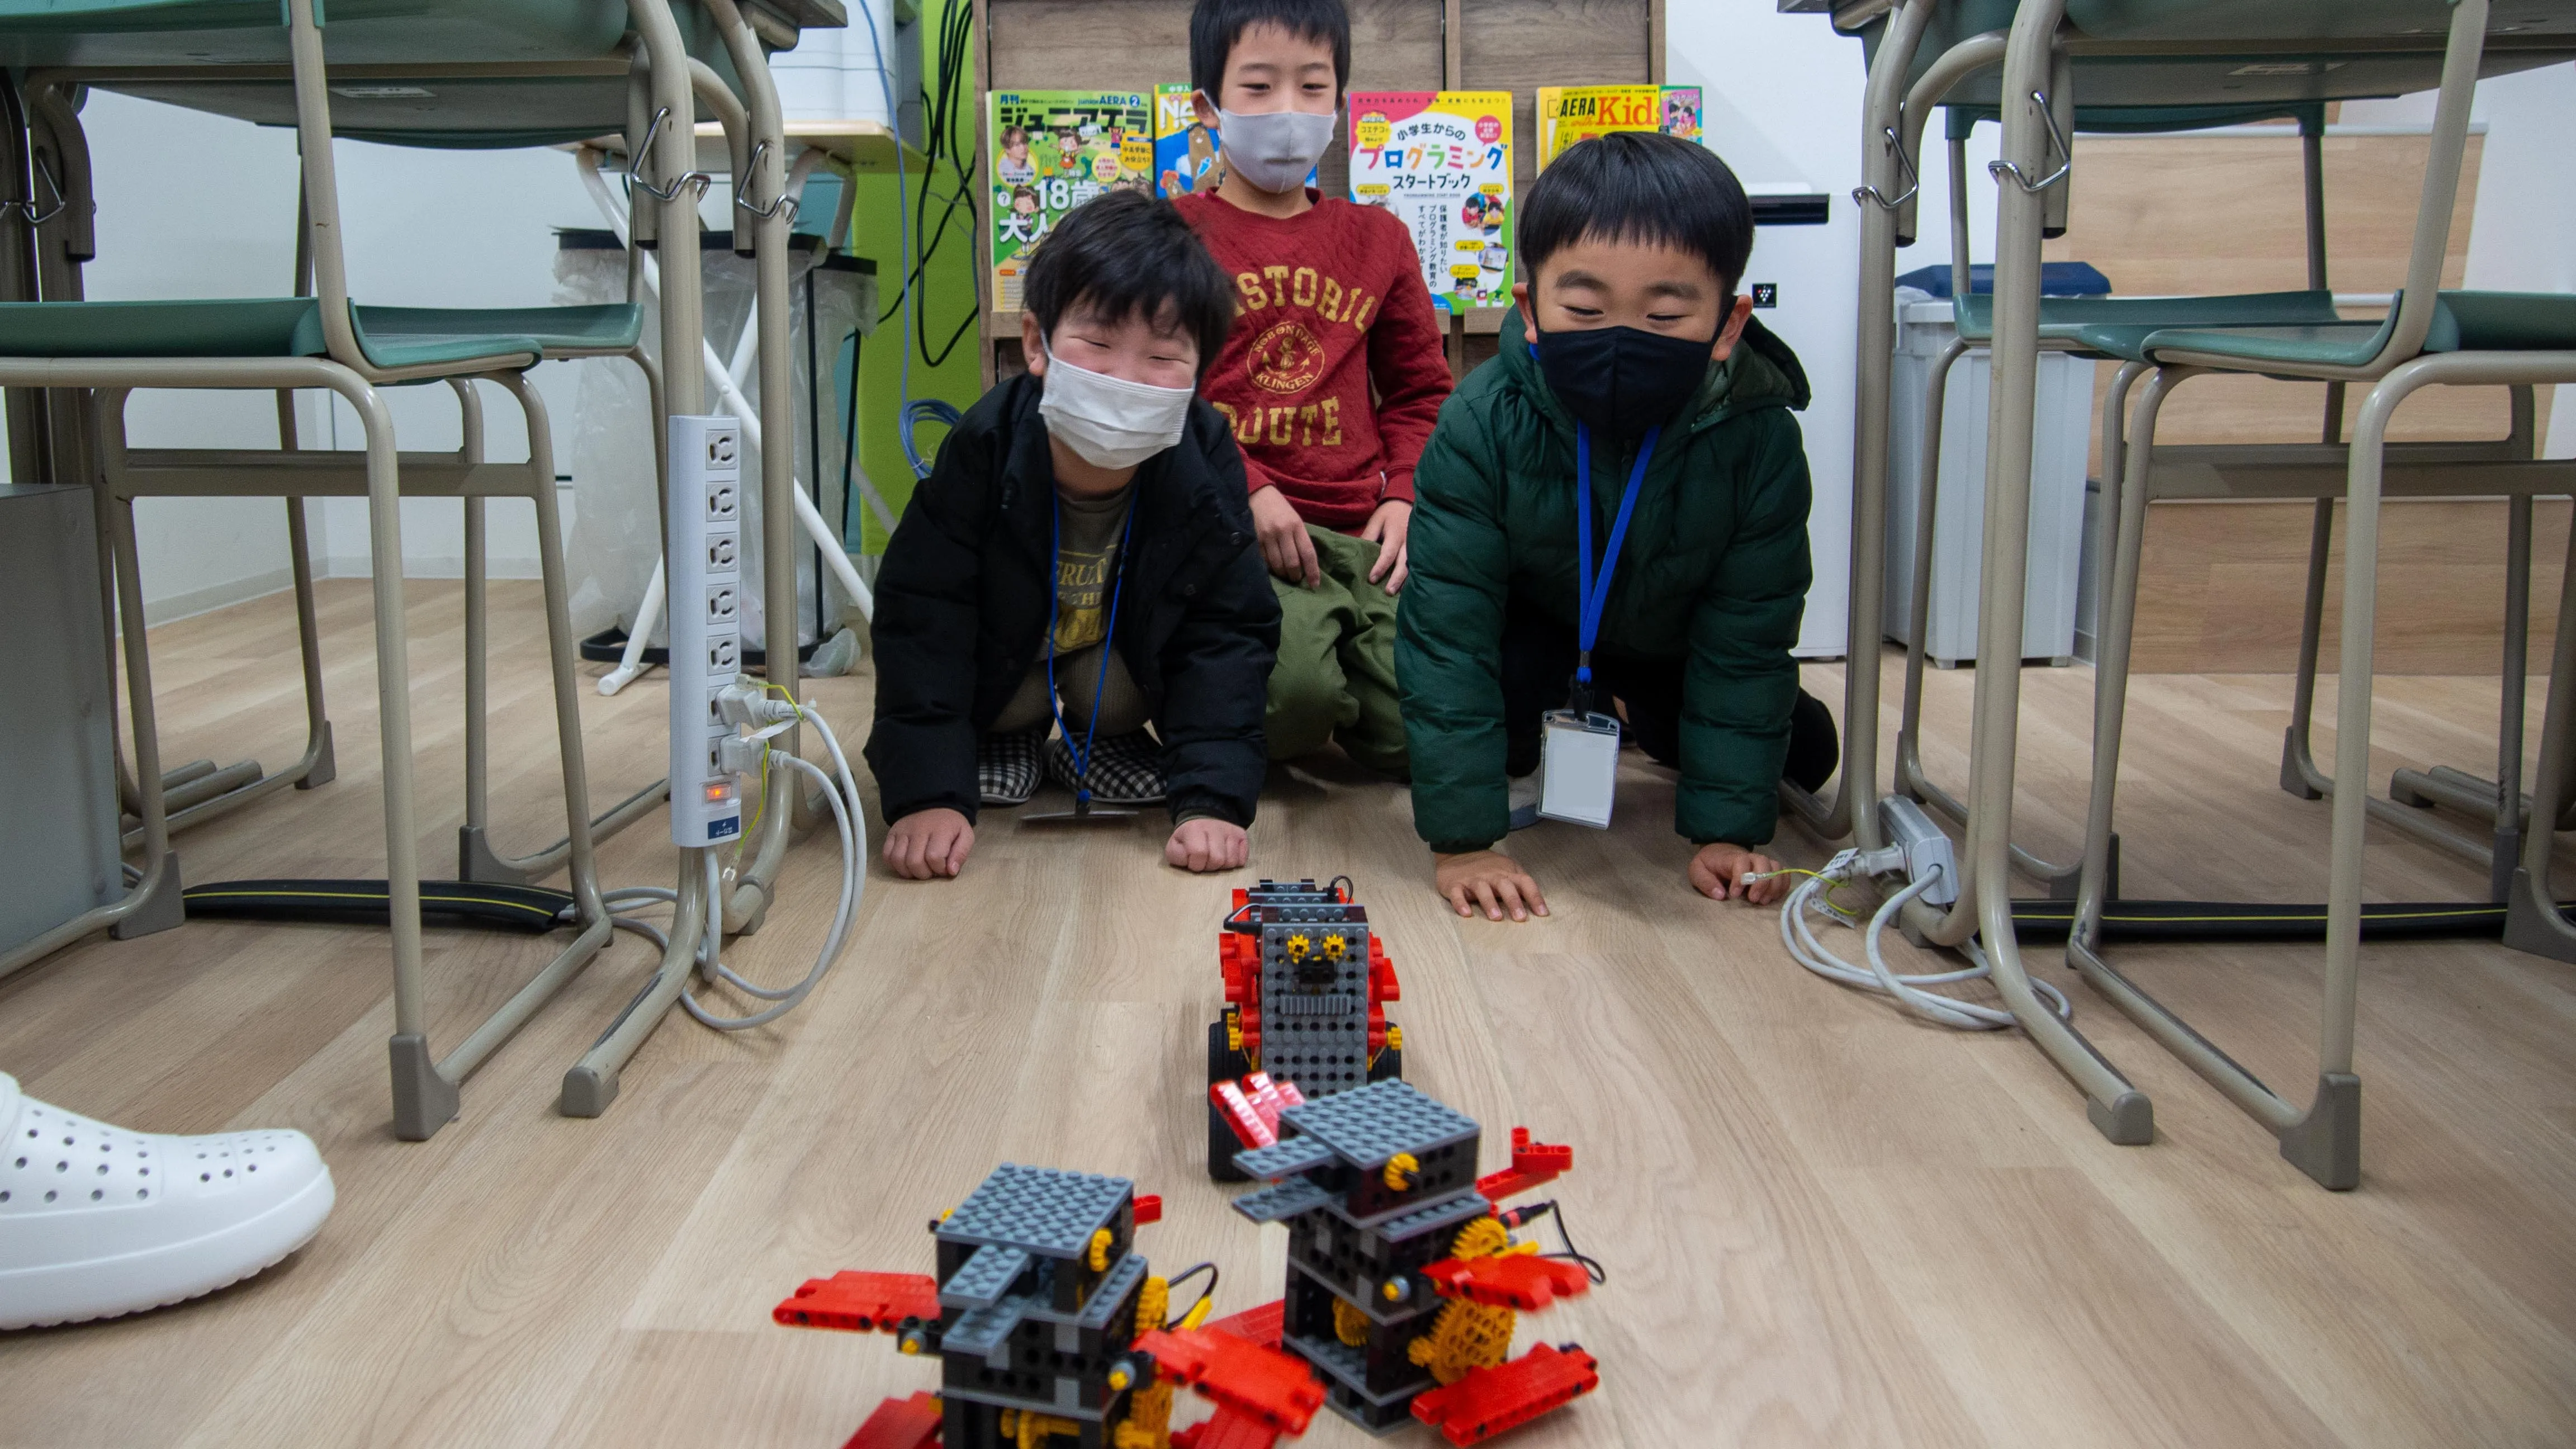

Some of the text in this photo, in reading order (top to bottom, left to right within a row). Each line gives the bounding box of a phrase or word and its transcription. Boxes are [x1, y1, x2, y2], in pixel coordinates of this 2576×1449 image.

[1000, 94, 1019, 105] 月刊
[1560, 97, 1595, 117] AERA
[1398, 122, 1466, 141] 小学生からの
[1359, 143, 1508, 171] プログラミング
[1393, 173, 1471, 190] スタートブック
[1256, 372, 1314, 390] KLINGEN
